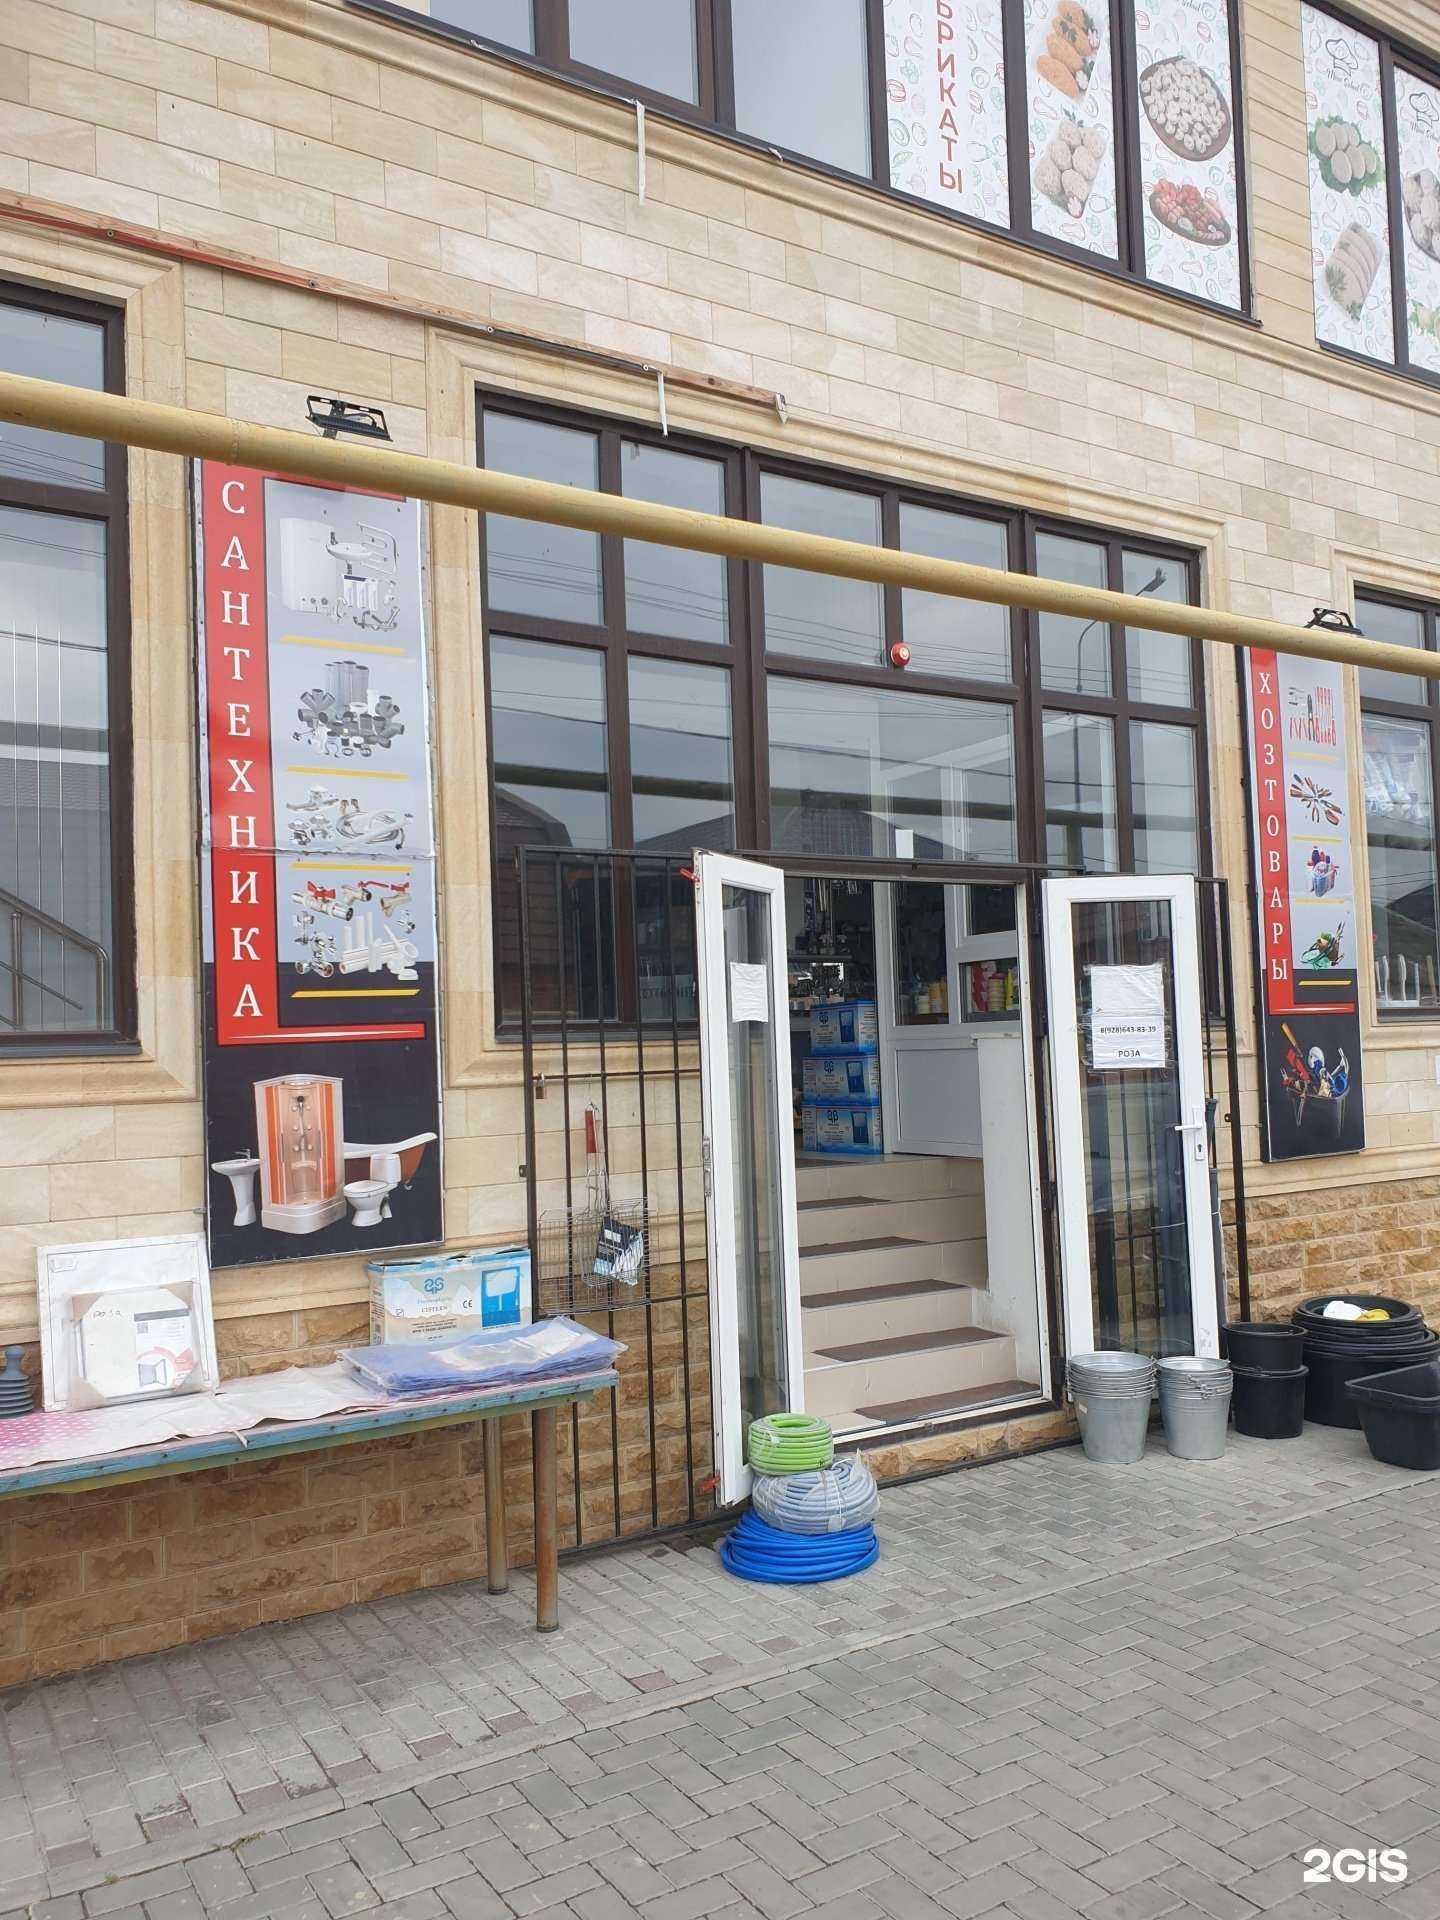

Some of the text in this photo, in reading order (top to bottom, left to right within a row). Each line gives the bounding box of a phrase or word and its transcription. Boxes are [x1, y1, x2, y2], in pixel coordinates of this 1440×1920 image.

[220, 480, 264, 1018] САНТЕХНИКА
[1259, 672, 1288, 981] ХОЗТОВАРЫ
[1118, 1049, 1141, 1058] РОЗА
